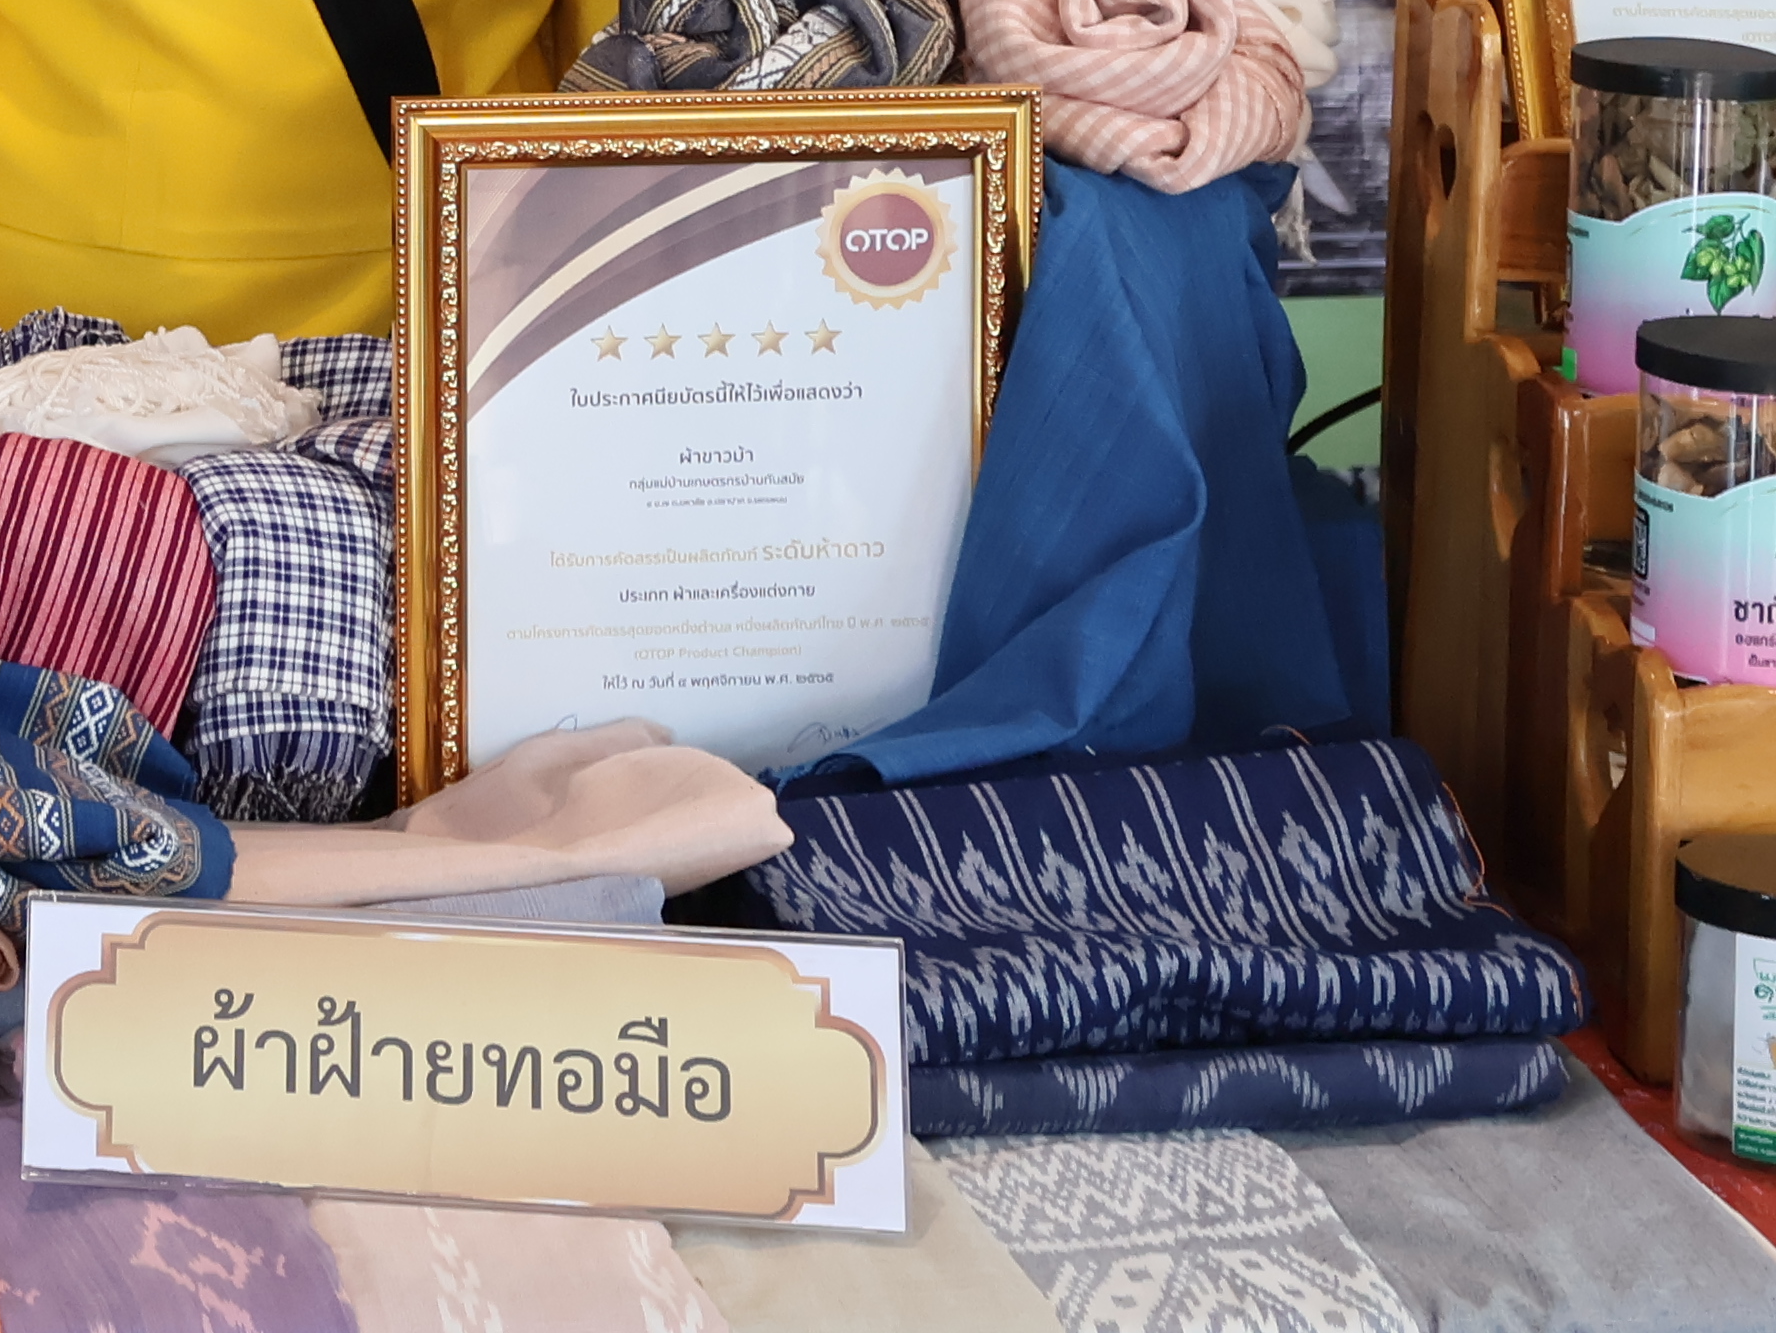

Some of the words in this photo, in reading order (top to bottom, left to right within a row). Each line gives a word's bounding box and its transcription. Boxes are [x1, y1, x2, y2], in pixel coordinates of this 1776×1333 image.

[845, 227, 929, 252] OTOP
[570, 379, 863, 408] ใบประกาศนียบัตรนี้ให้ไว้เพื่อแสดงว่า
[191, 988, 732, 1123] ผ้าฝ้ายทอมือ
